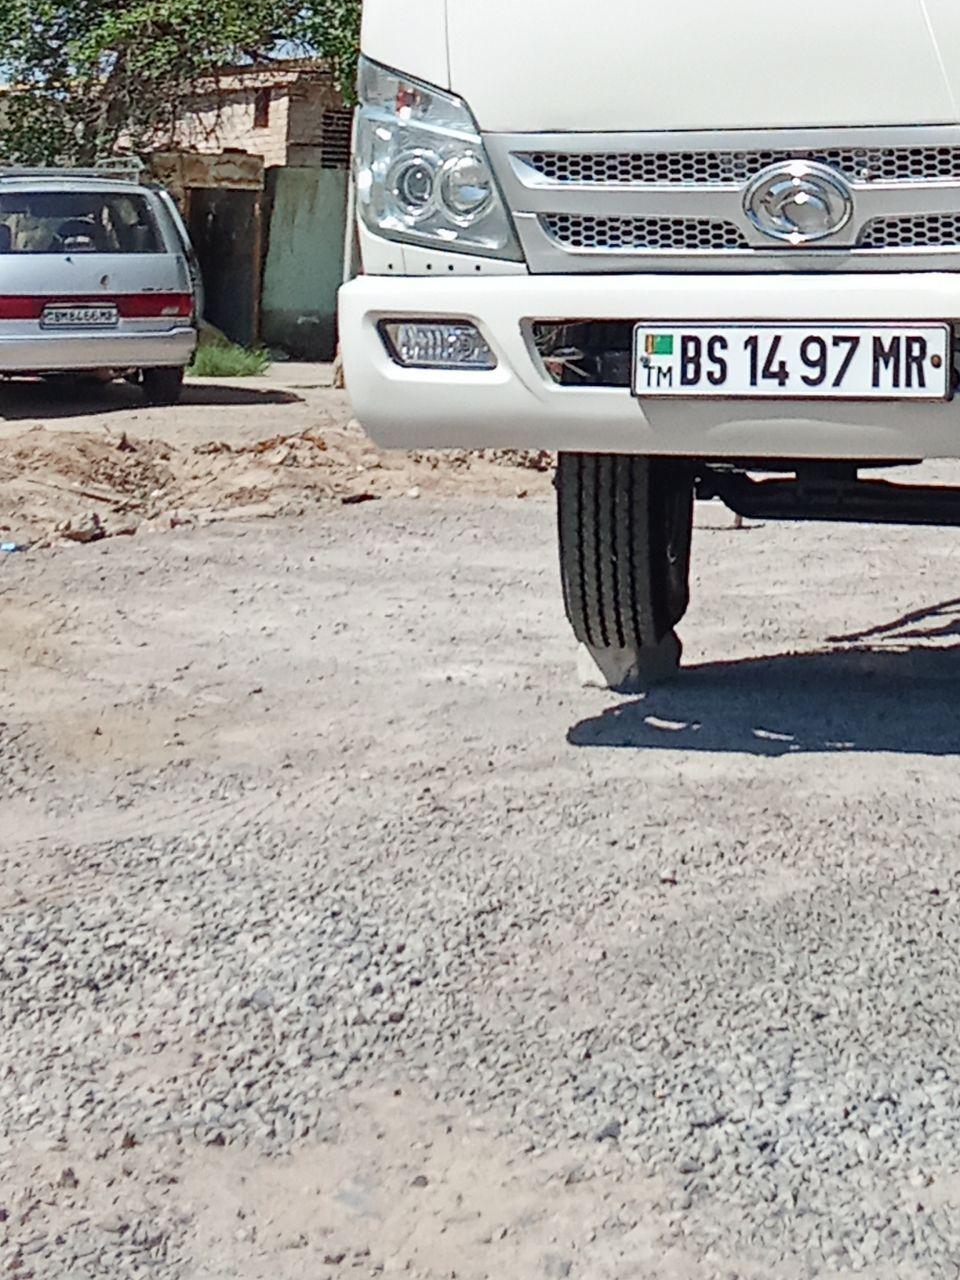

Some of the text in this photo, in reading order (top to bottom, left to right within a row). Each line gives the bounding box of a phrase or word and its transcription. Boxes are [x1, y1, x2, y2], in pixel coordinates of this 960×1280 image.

[645, 365, 673, 388] TM
[680, 334, 728, 387] BS
[872, 334, 927, 389] MR
